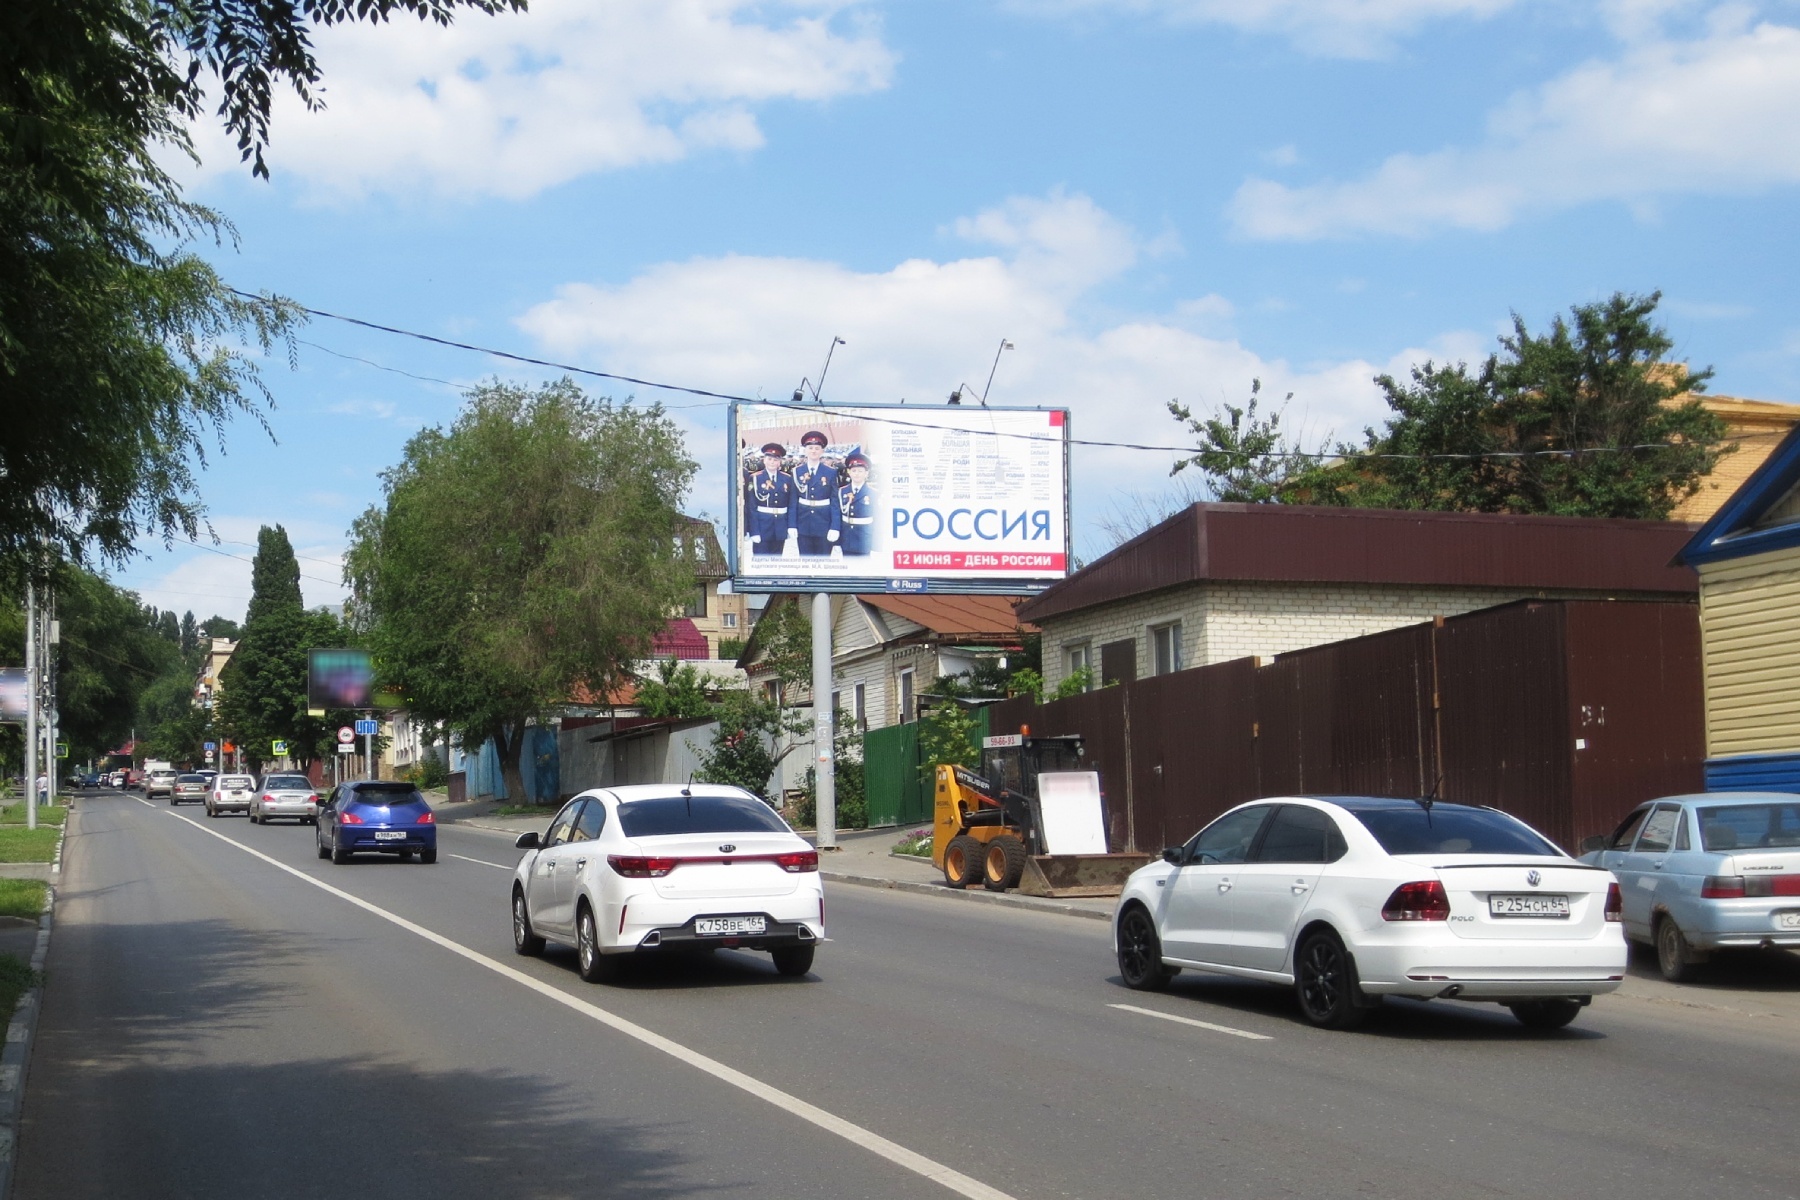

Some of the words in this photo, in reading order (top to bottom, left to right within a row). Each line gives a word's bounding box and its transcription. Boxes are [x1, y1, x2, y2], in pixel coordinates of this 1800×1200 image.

[892, 507, 1050, 541] РОССИЯ
[896, 554, 910, 565] 12
[913, 554, 951, 565] ИЮНЯ
[964, 555, 999, 567] ДЕНЬ
[1001, 555, 1052, 566] РОССИИ
[901, 580, 922, 589] Russ
[1496, 897, 1549, 912] Р254СН
[699, 918, 744, 932] К758ВЕ
[1451, 915, 1475, 923] POLO
